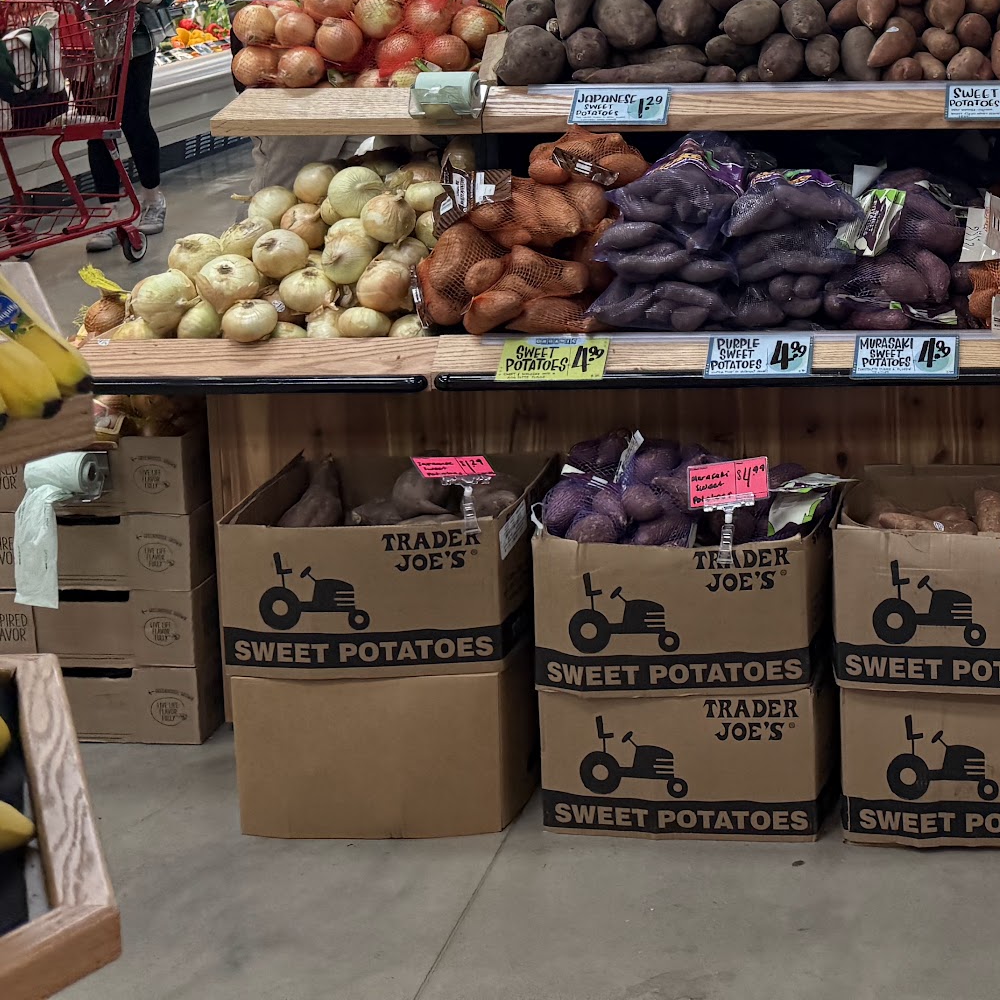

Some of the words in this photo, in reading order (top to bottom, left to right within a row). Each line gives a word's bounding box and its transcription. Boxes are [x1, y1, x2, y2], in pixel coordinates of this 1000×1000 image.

[578, 94, 637, 103] JAPANESE
[954, 88, 999, 98] SWEET
[717, 338, 760, 350] PURPLE
[860, 338, 913, 350] MURASAKI
[516, 345, 559, 359] SWEET
[720, 349, 754, 360] SWEET
[870, 350, 904, 358] SWEET
[506, 358, 568, 372] POTATOES
[711, 360, 762, 370] POTATOES
[862, 357, 910, 367] POTATOES
[382, 528, 480, 551] TRADER
[395, 549, 466, 571] JOE'S
[693, 547, 790, 570] TRADER
[705, 571, 776, 592] JOE'S
[0, 614, 28, 627] PIRED
[0, 628, 26, 642] AVOR
[234, 639, 329, 663] SWEET
[339, 636, 494, 662] POTATOES
[547, 662, 640, 686] SWEET
[650, 658, 803, 685] POTATOES
[845, 654, 942, 680] SWEET
[703, 699, 799, 718] TRADER
[715, 722, 785, 741] JOE'S
[555, 803, 648, 828] SWEET
[658, 810, 809, 831] POTATOES
[859, 808, 955, 833] SWEET
